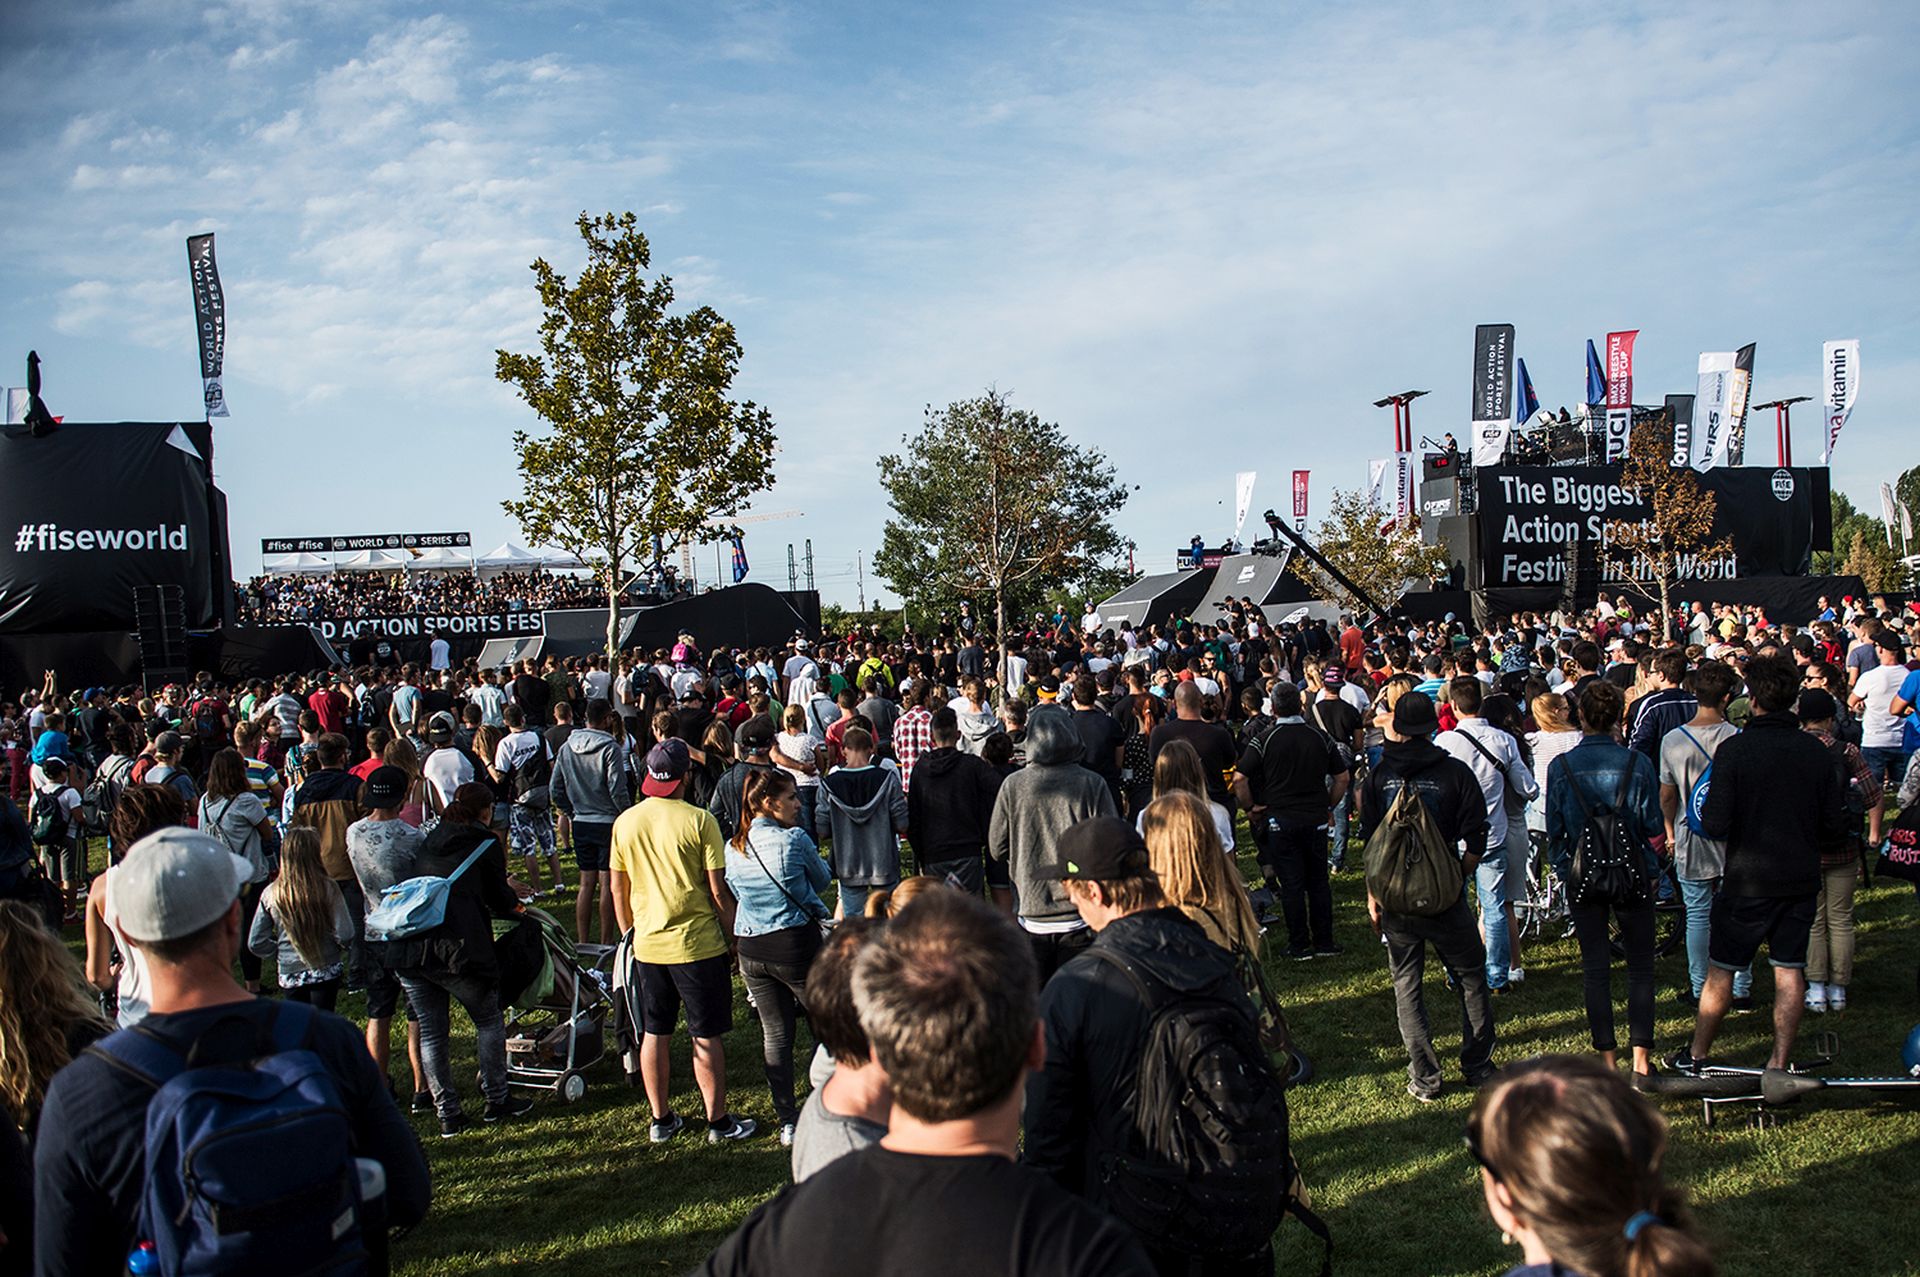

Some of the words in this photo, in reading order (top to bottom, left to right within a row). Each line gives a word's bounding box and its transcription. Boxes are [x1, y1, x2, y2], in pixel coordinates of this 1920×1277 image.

[193, 260, 210, 315] ACTION
[202, 239, 222, 310] FESTIVAL
[203, 321, 216, 373] WORLD
[1488, 344, 1496, 380] ACTION
[1497, 332, 1506, 378] FESTIVAL
[1611, 336, 1621, 381] FREESTYLE
[1620, 351, 1628, 370] CUP
[1495, 380, 1504, 416] SPORTS
[1610, 380, 1619, 405] BMX
[1619, 371, 1628, 405] WORLD
[1830, 348, 1846, 413] vitamin
[1486, 384, 1495, 417] WORLD
[1609, 412, 1627, 456] UCI
[1397, 457, 1407, 501] vitamin
[1498, 475, 1547, 504] The
[1552, 476, 1643, 512] Biggest
[15, 523, 188, 552] #fiseworld
[267, 540, 293, 551] #fise
[298, 539, 324, 550] #fise
[349, 538, 384, 549] WORLD
[420, 535, 453, 546] SERIES
[1502, 514, 1579, 543] Action
[1602, 553, 1624, 580] in
[1675, 553, 1737, 580] World
[342, 617, 419, 639] ACTION
[424, 613, 501, 634] SPORTS
